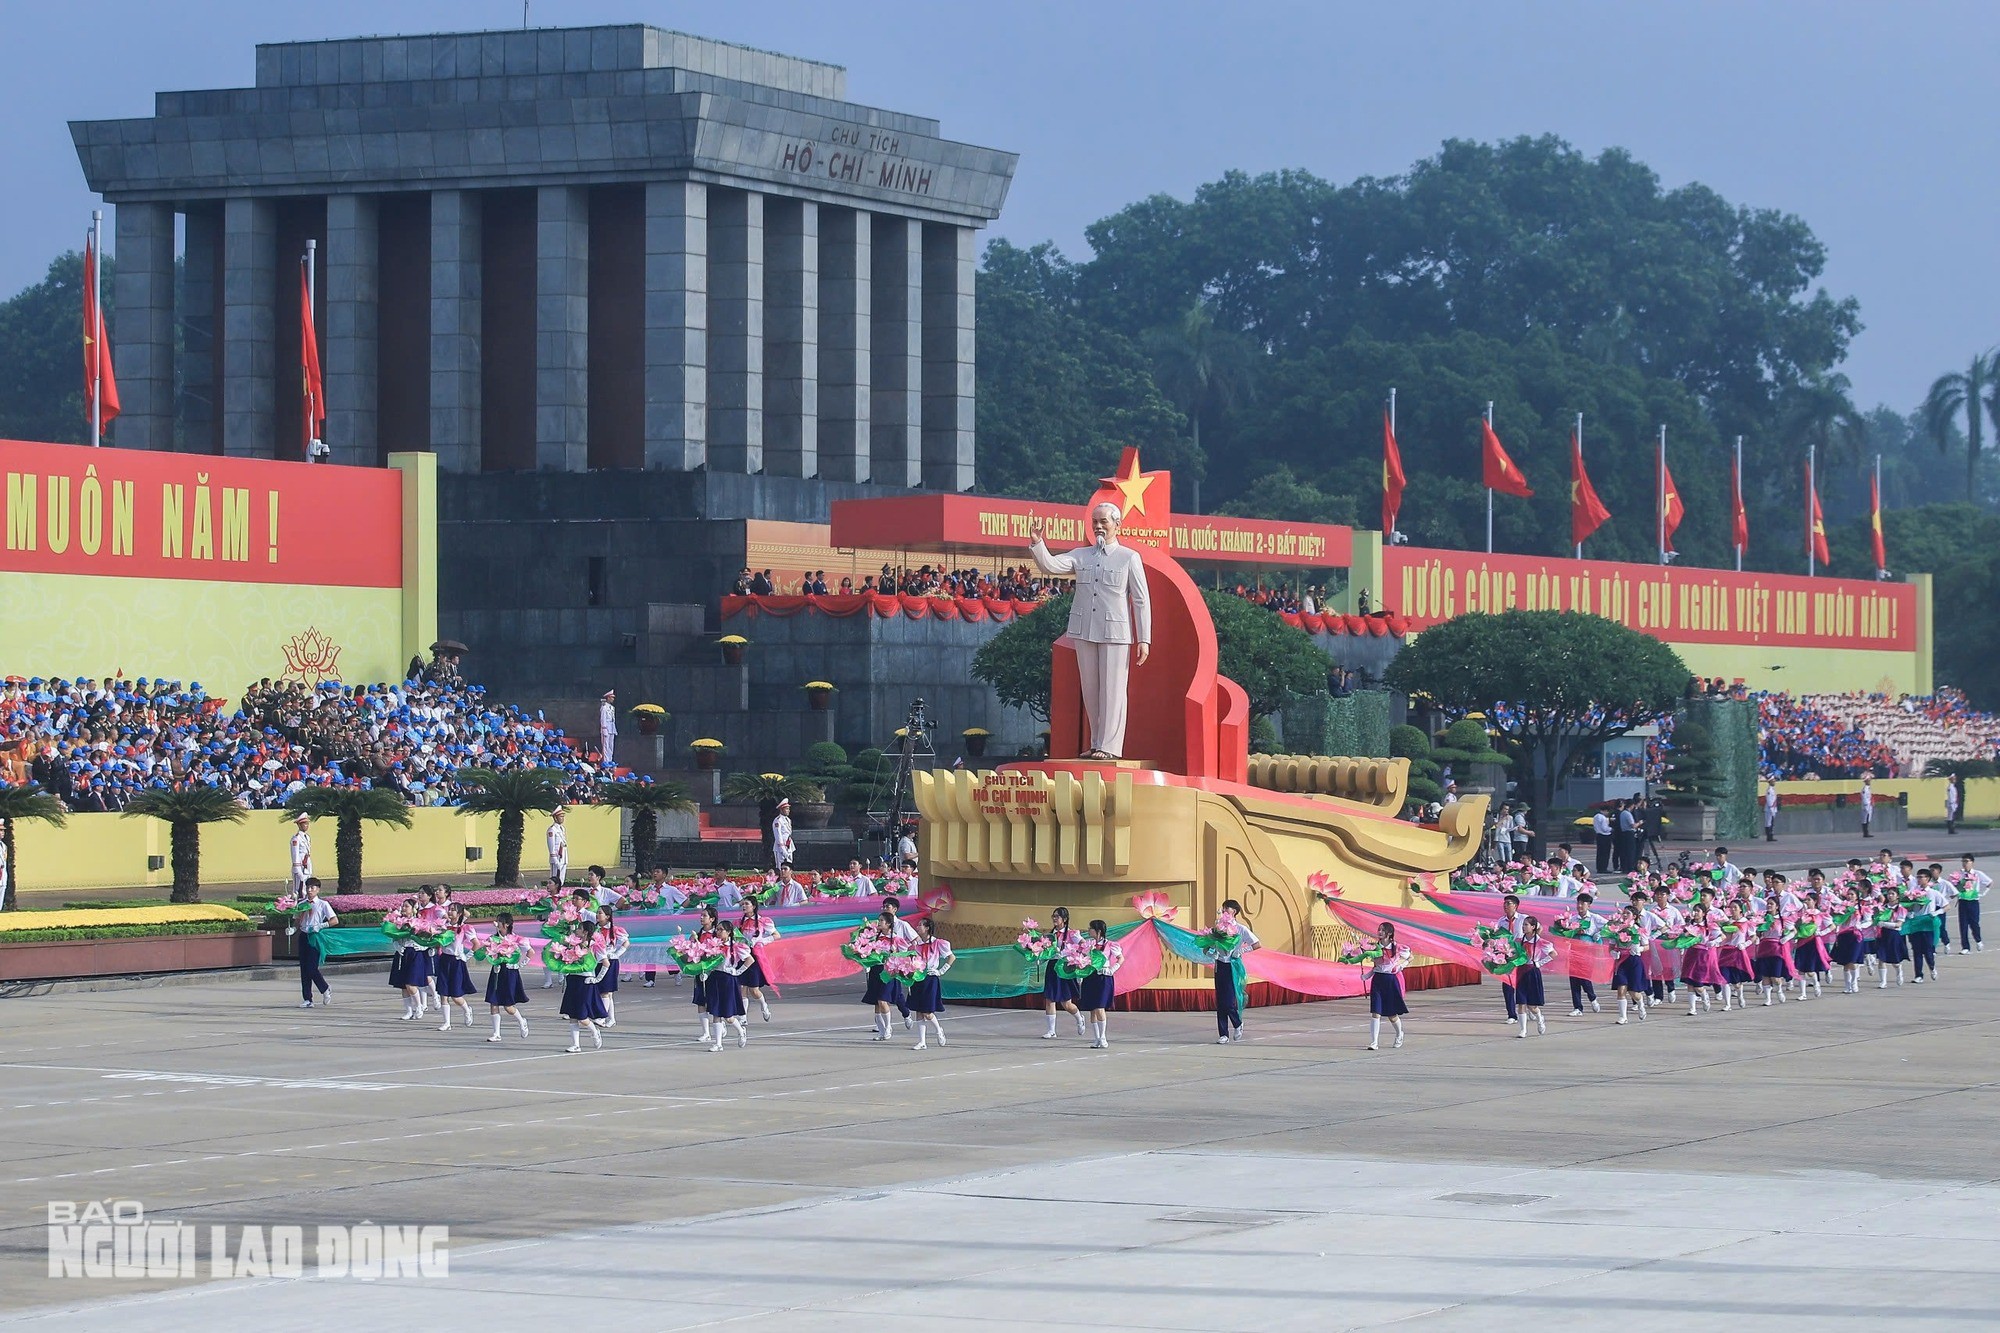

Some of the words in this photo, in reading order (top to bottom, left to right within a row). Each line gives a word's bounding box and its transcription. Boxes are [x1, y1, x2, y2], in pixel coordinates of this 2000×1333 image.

[7, 464, 134, 556] MUÔN
[162, 472, 249, 562] NĂM
[979, 512, 1008, 537] TINH
[1046, 513, 1075, 541] CÁCH
[1175, 523, 1189, 549] VÀ
[1191, 523, 1218, 551] QUỐC
[1220, 527, 1254, 553] KHÁNH
[1256, 532, 1275, 554] 2-9
[1277, 528, 1297, 556] BẤT
[1402, 558, 1455, 620] NƯỚC
[1526, 566, 1560, 612] HÒA
[1570, 569, 1591, 616] XÃ
[1638, 571, 1671, 630] CHỦ
[1680, 579, 1729, 632] NGHĨA
[1736, 580, 1770, 641] VIỆT
[1776, 590, 1808, 635] NAM
[1814, 586, 1855, 637] MUÔN
[973, 784, 988, 801] HỒ
[992, 787, 1011, 803] CHÍ
[1016, 790, 1048, 803] MINH
[985, 773, 1006, 786] CHỦ
[1009, 776, 1034, 788] TỊCH
